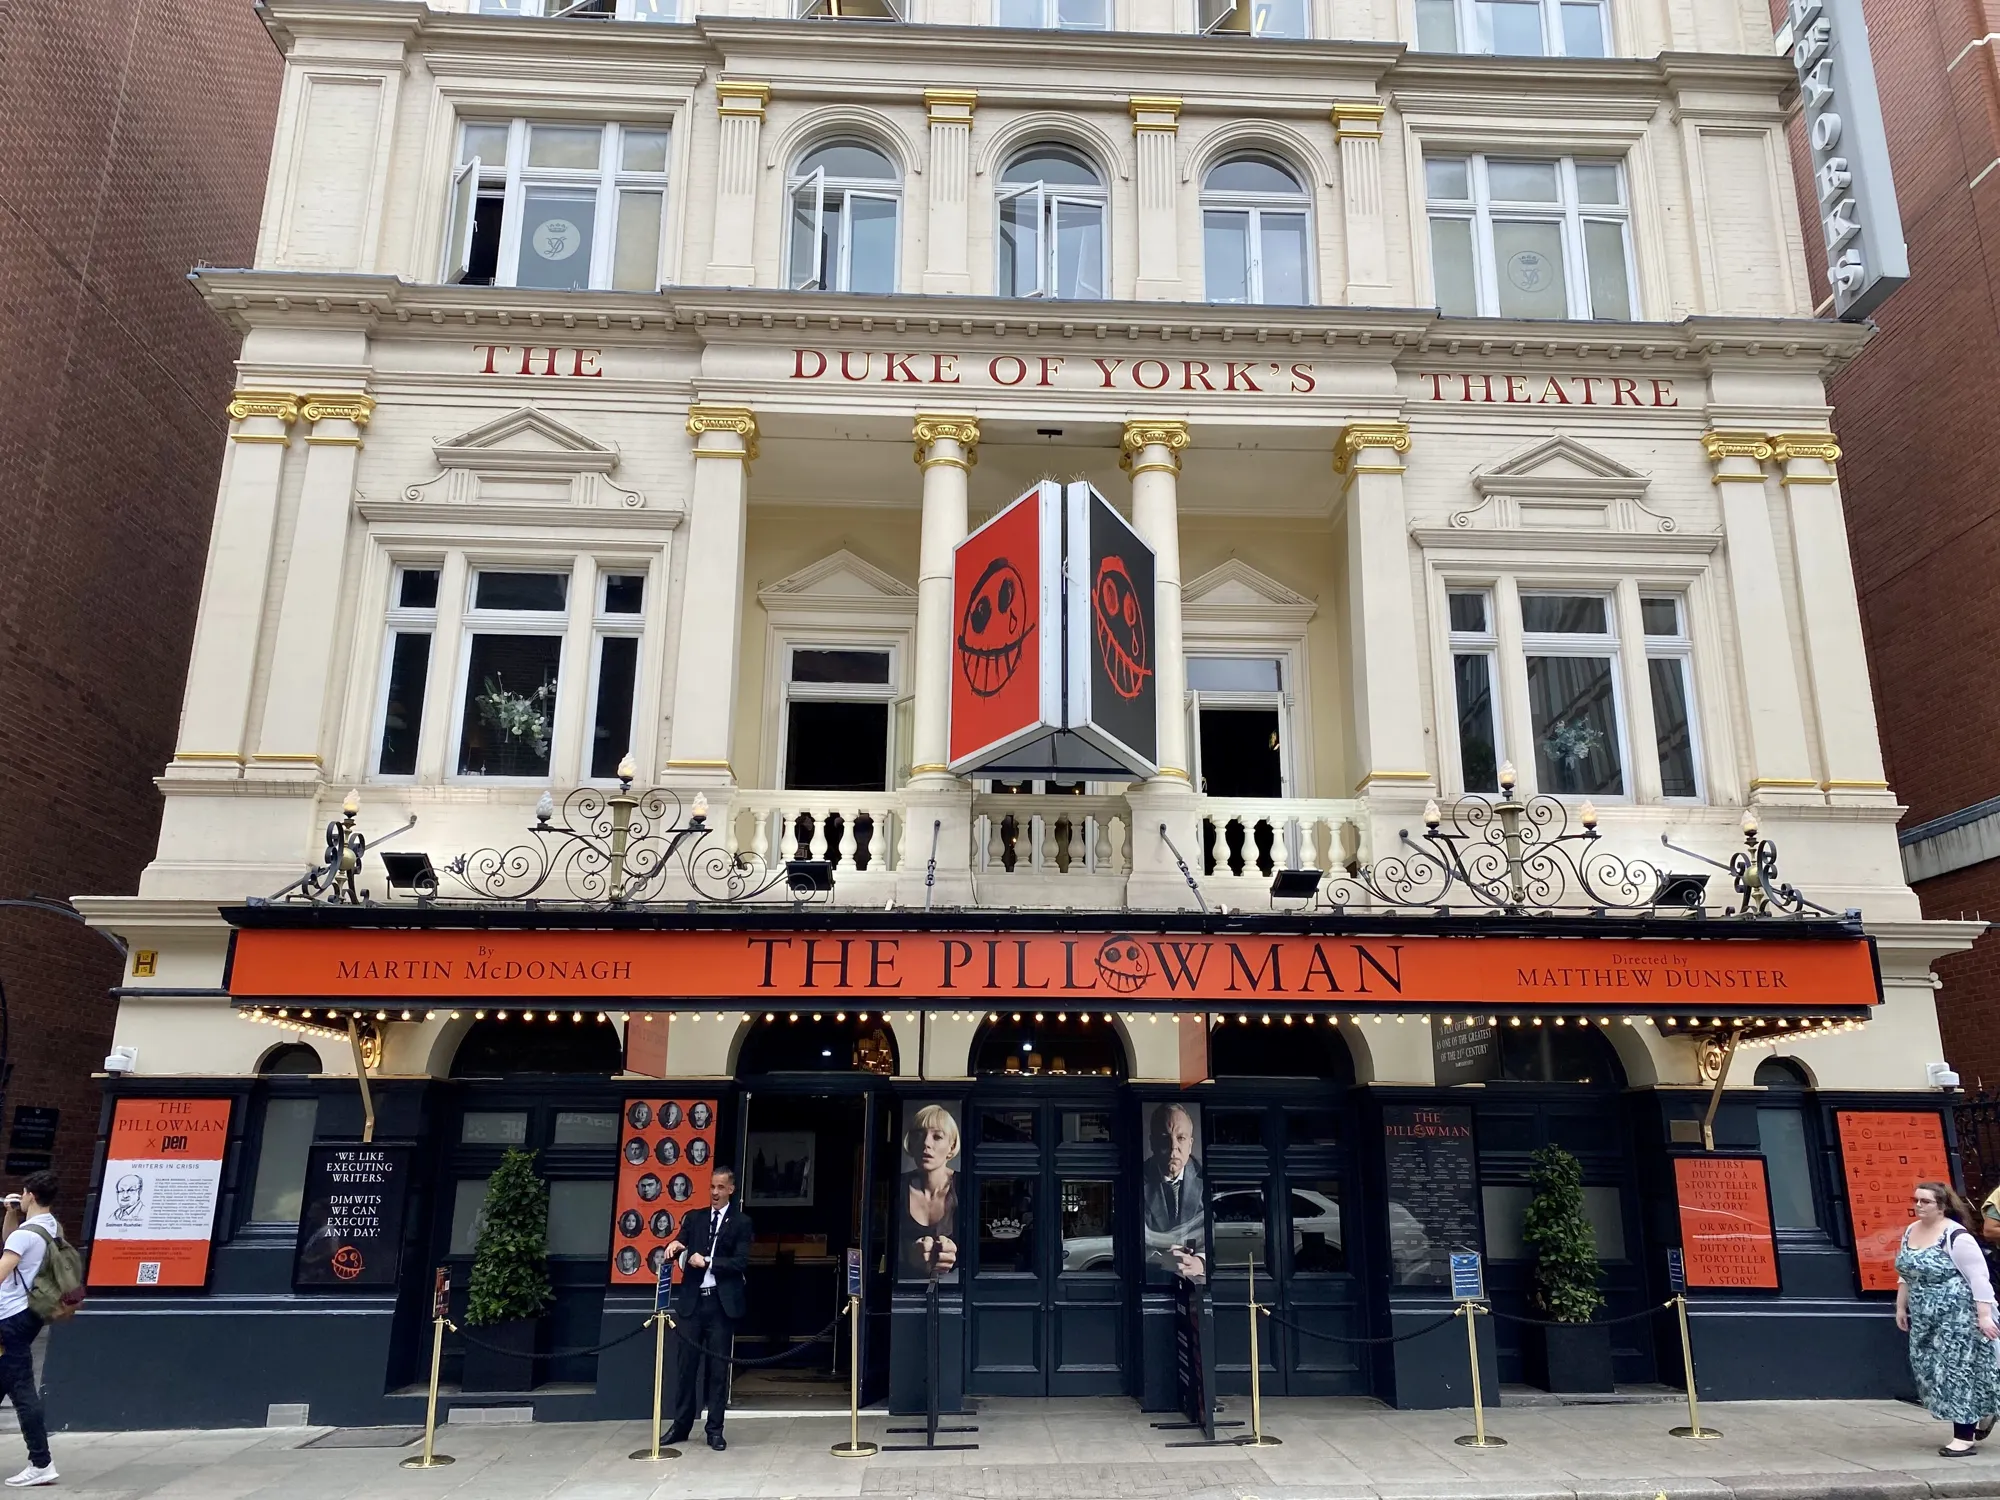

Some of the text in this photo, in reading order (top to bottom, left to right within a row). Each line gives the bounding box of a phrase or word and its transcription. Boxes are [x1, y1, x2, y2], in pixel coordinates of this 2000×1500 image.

[472, 345, 1679, 408] THE DUKE OF YORK'S THEATRE
[477, 945, 495, 958] By
[747, 935, 1404, 994] THE PILLOWMAN
[1612, 953, 1688, 968] Directed by
[335, 960, 632, 981] MARTIN McDONAGH
[1517, 968, 1789, 989] MATTHEW DUNSTER
[1468, 1028, 1492, 1042] GREATEST
[158, 1102, 192, 1114] THE
[1413, 1112, 1441, 1123] THE
[118, 1119, 226, 1132] PILLOWMAN
[161, 1135, 188, 1152] pen
[359, 1152, 384, 1160] LIKE
[326, 1162, 393, 1172] EXECUTING
[332, 1174, 385, 1182] WRITERS.
[1724, 1171, 1736, 1179] OF
[1685, 1181, 1758, 1190] STORYTELLER
[330, 1196, 382, 1204] DIMWITS
[1694, 1192, 1704, 1200] IS
[332, 1206, 376, 1215] WE CAN
[1700, 1202, 1707, 1210] A
[327, 1217, 380, 1226] EXECUTE
[324, 1228, 350, 1237] ANY
[1700, 1244, 1757, 1252] DUTY OF A
[1693, 1255, 1766, 1264] STORYTELLER
[1734, 1266, 1760, 1274] TELL
